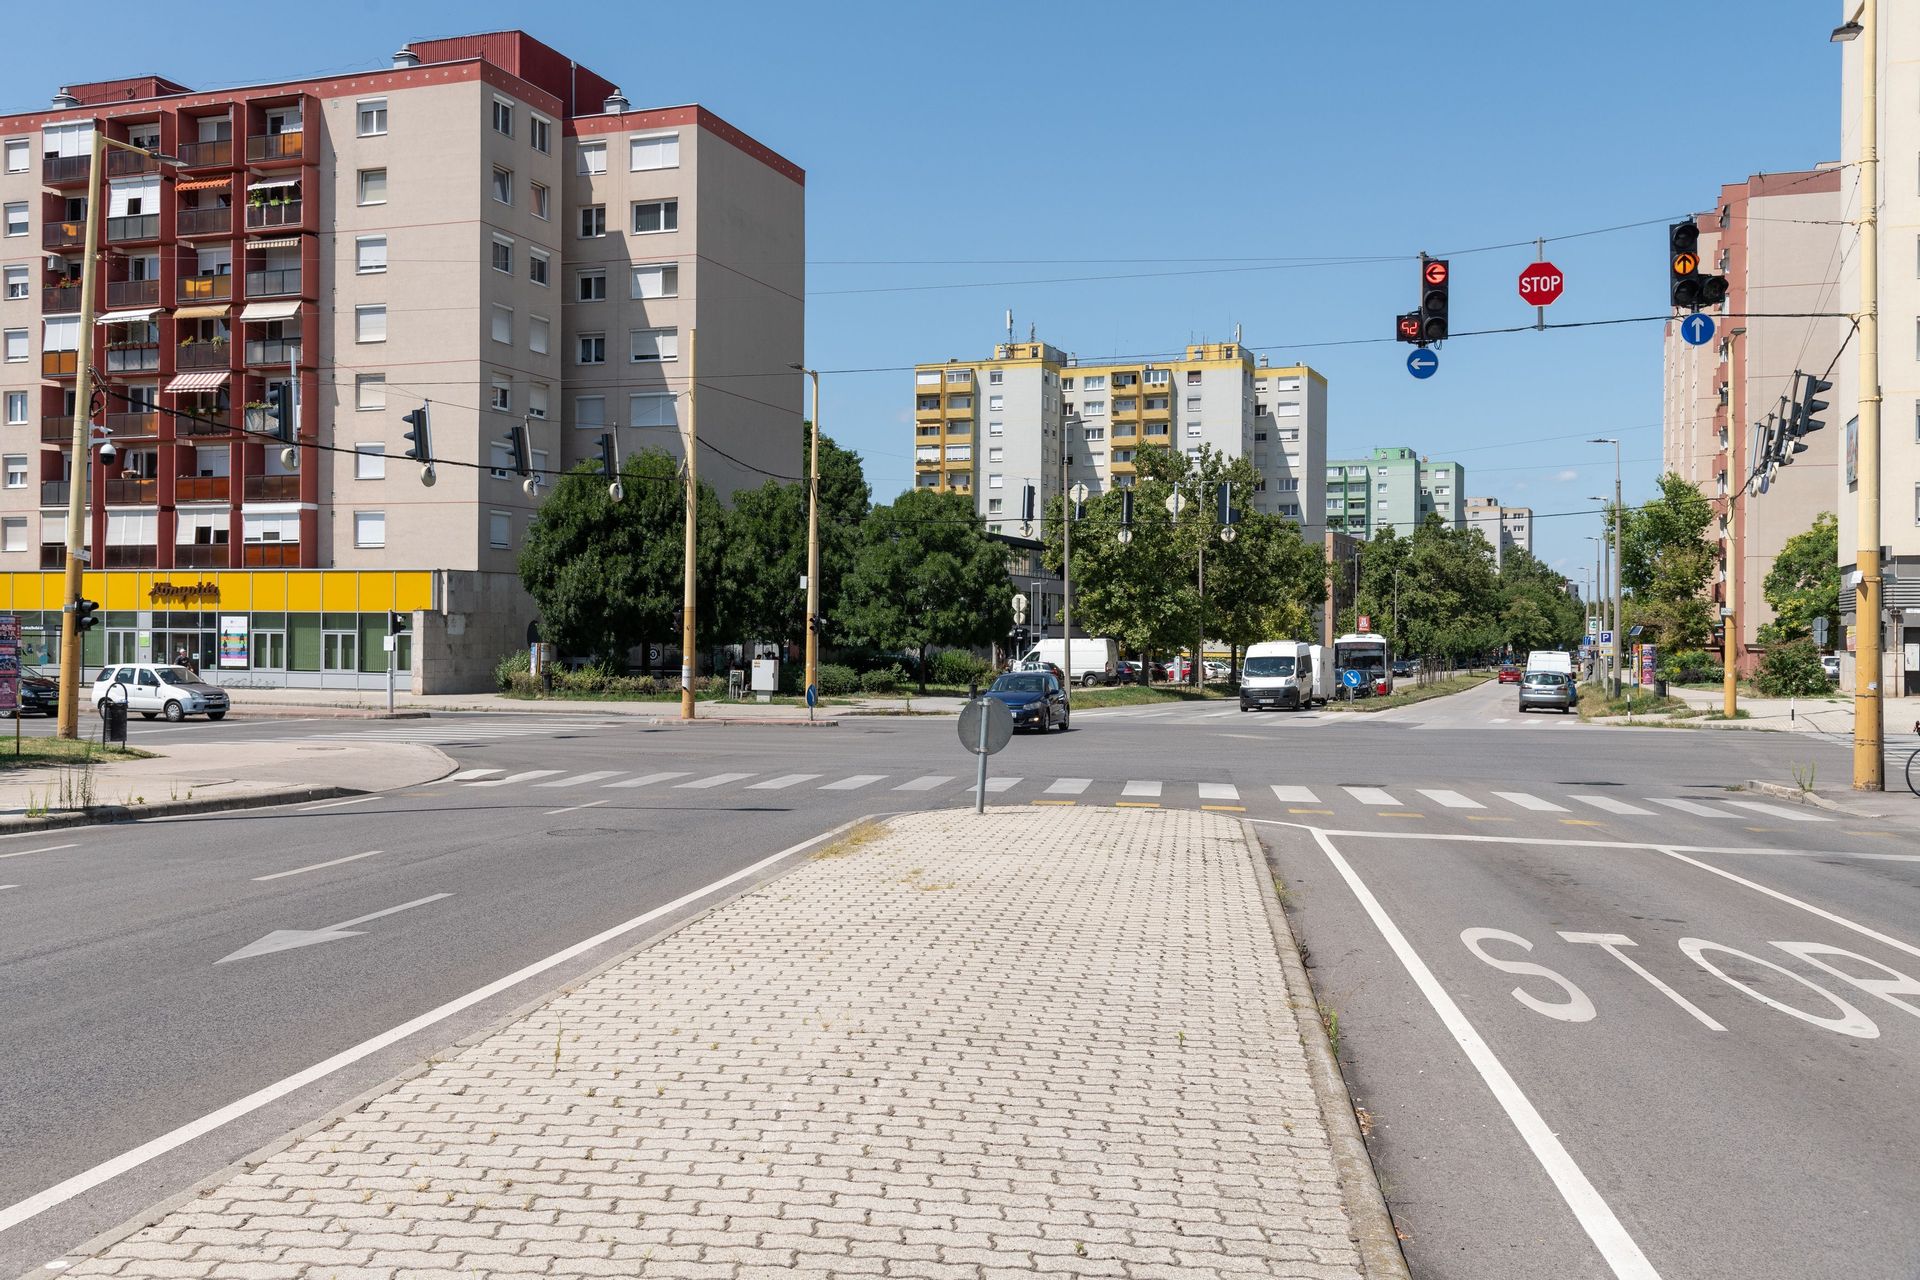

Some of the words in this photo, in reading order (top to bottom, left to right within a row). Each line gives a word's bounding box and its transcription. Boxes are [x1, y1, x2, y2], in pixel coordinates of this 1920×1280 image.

[1521, 275, 1561, 293] STOP
[1401, 321, 1418, 335] 52
[1603, 634, 1609, 642] P
